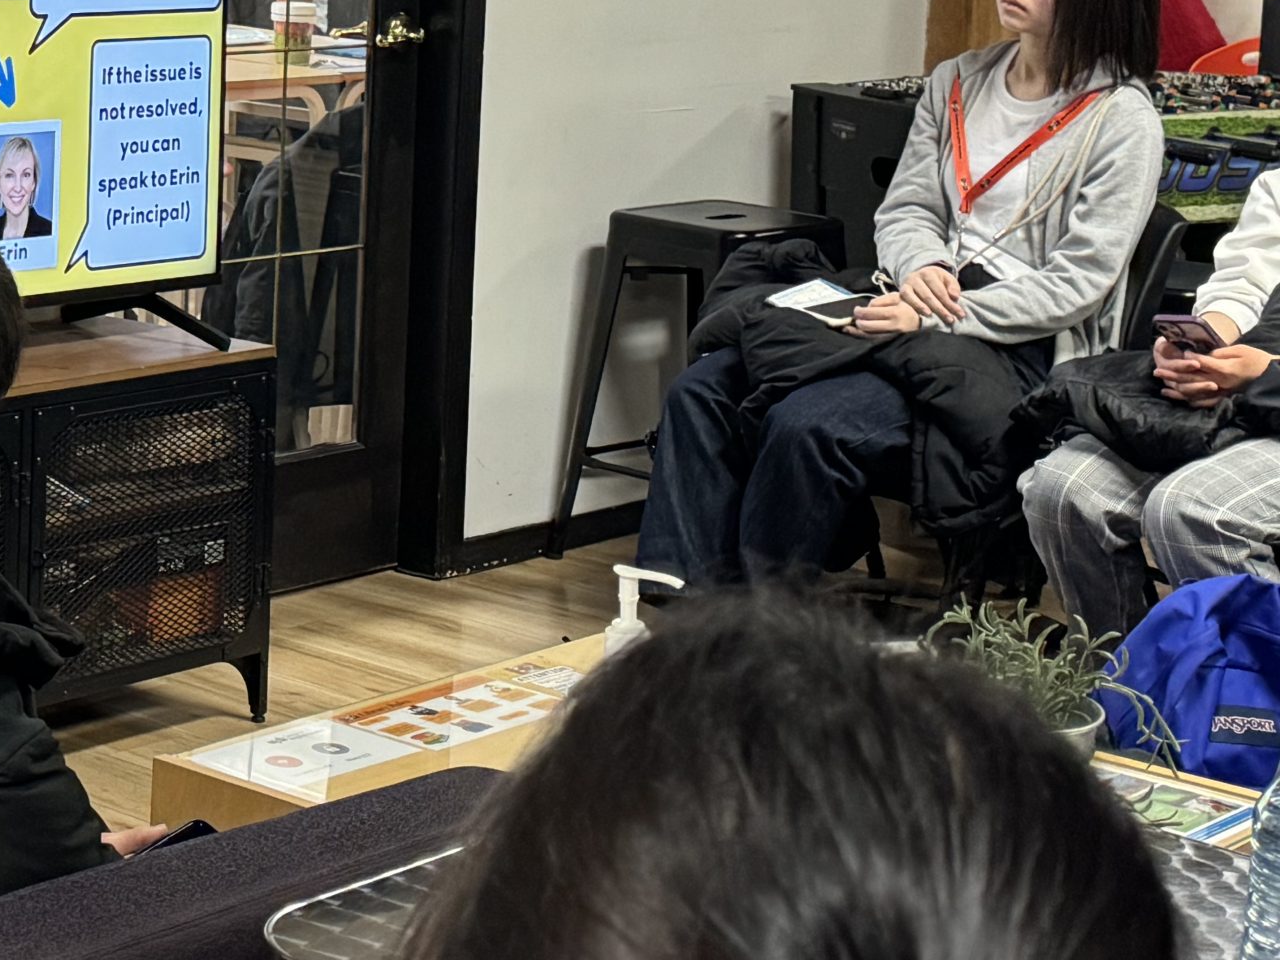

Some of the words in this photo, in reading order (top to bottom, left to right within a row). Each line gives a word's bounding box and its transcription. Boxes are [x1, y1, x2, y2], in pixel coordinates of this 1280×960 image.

[102, 66, 114, 85] If
[116, 66, 142, 84] the
[144, 64, 187, 83] issue
[189, 61, 202, 80] is
[99, 102, 126, 121] not
[128, 97, 203, 119] resolved,
[120, 140, 149, 161] you
[151, 137, 181, 152] can
[98, 171, 148, 198] speak
[151, 171, 167, 187] to
[170, 166, 200, 185] Erin
[106, 200, 190, 230] (Principal)
[1212, 715, 1273, 734] JANSPORT
